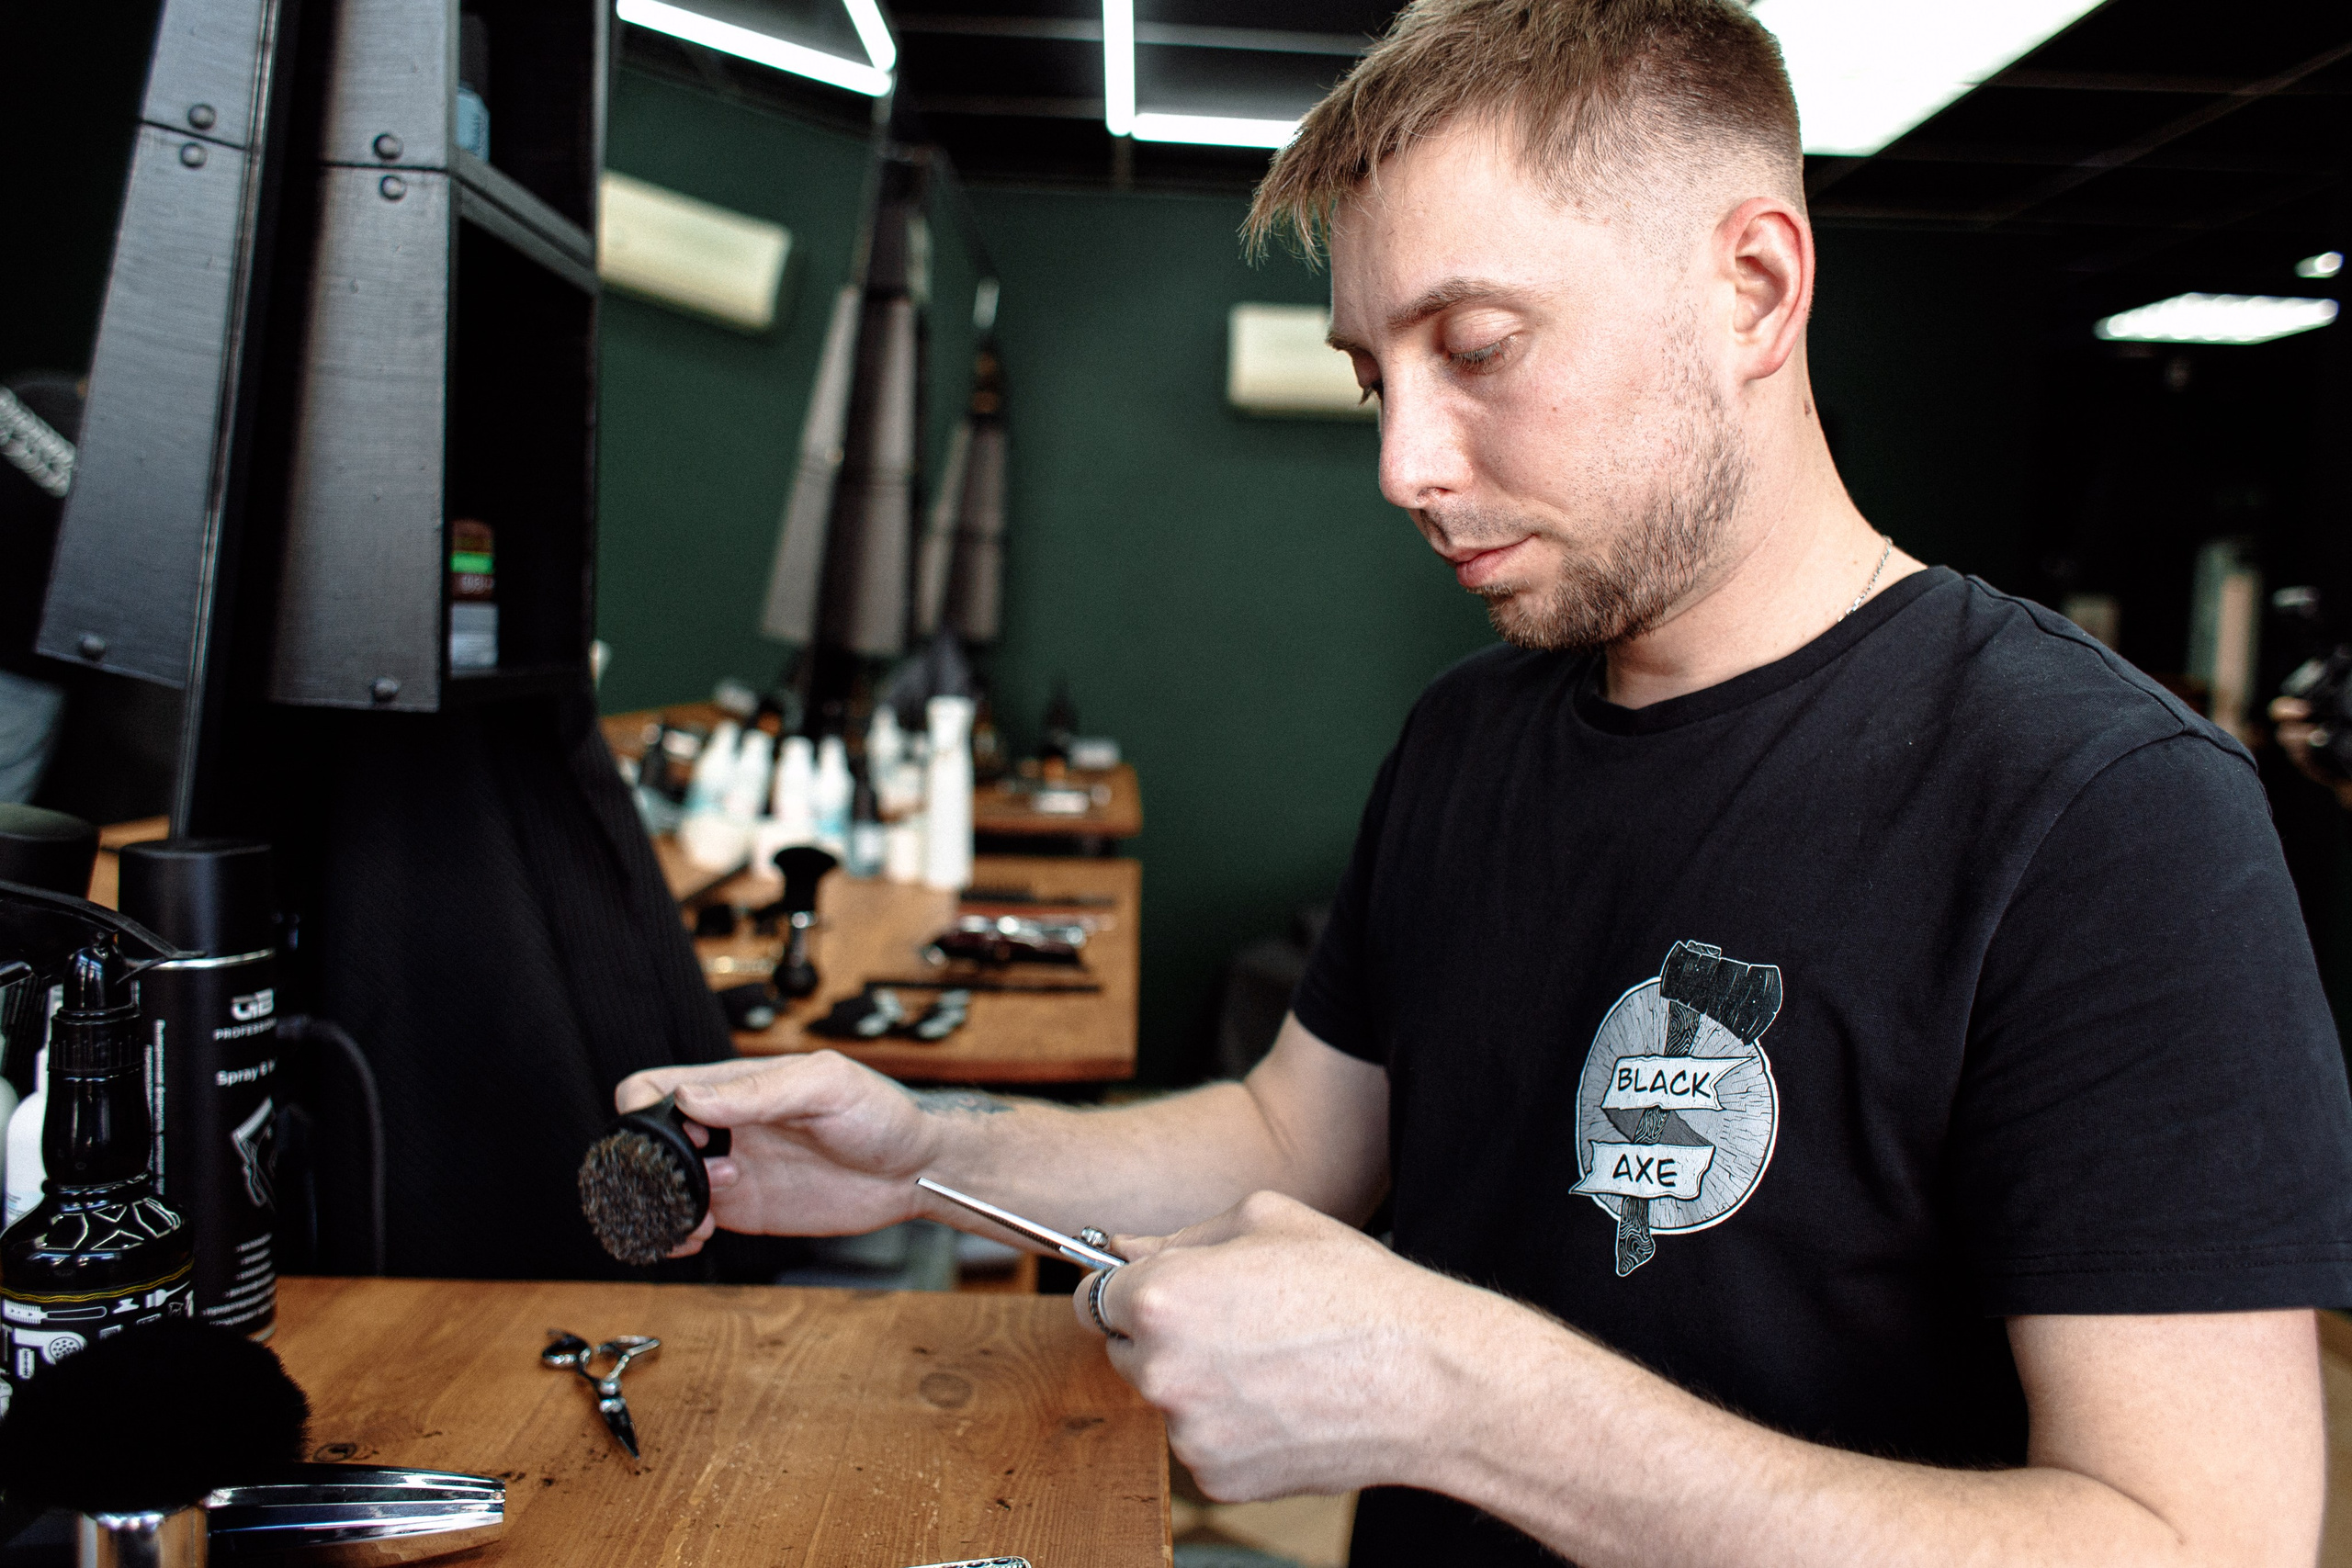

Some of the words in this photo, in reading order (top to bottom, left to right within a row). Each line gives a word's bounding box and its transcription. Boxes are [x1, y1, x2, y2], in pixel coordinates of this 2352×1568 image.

[216, 1067, 258, 1087] Spray
[1617, 1067, 1711, 1100] BLACK
[1612, 1153, 1679, 1188] AXE
